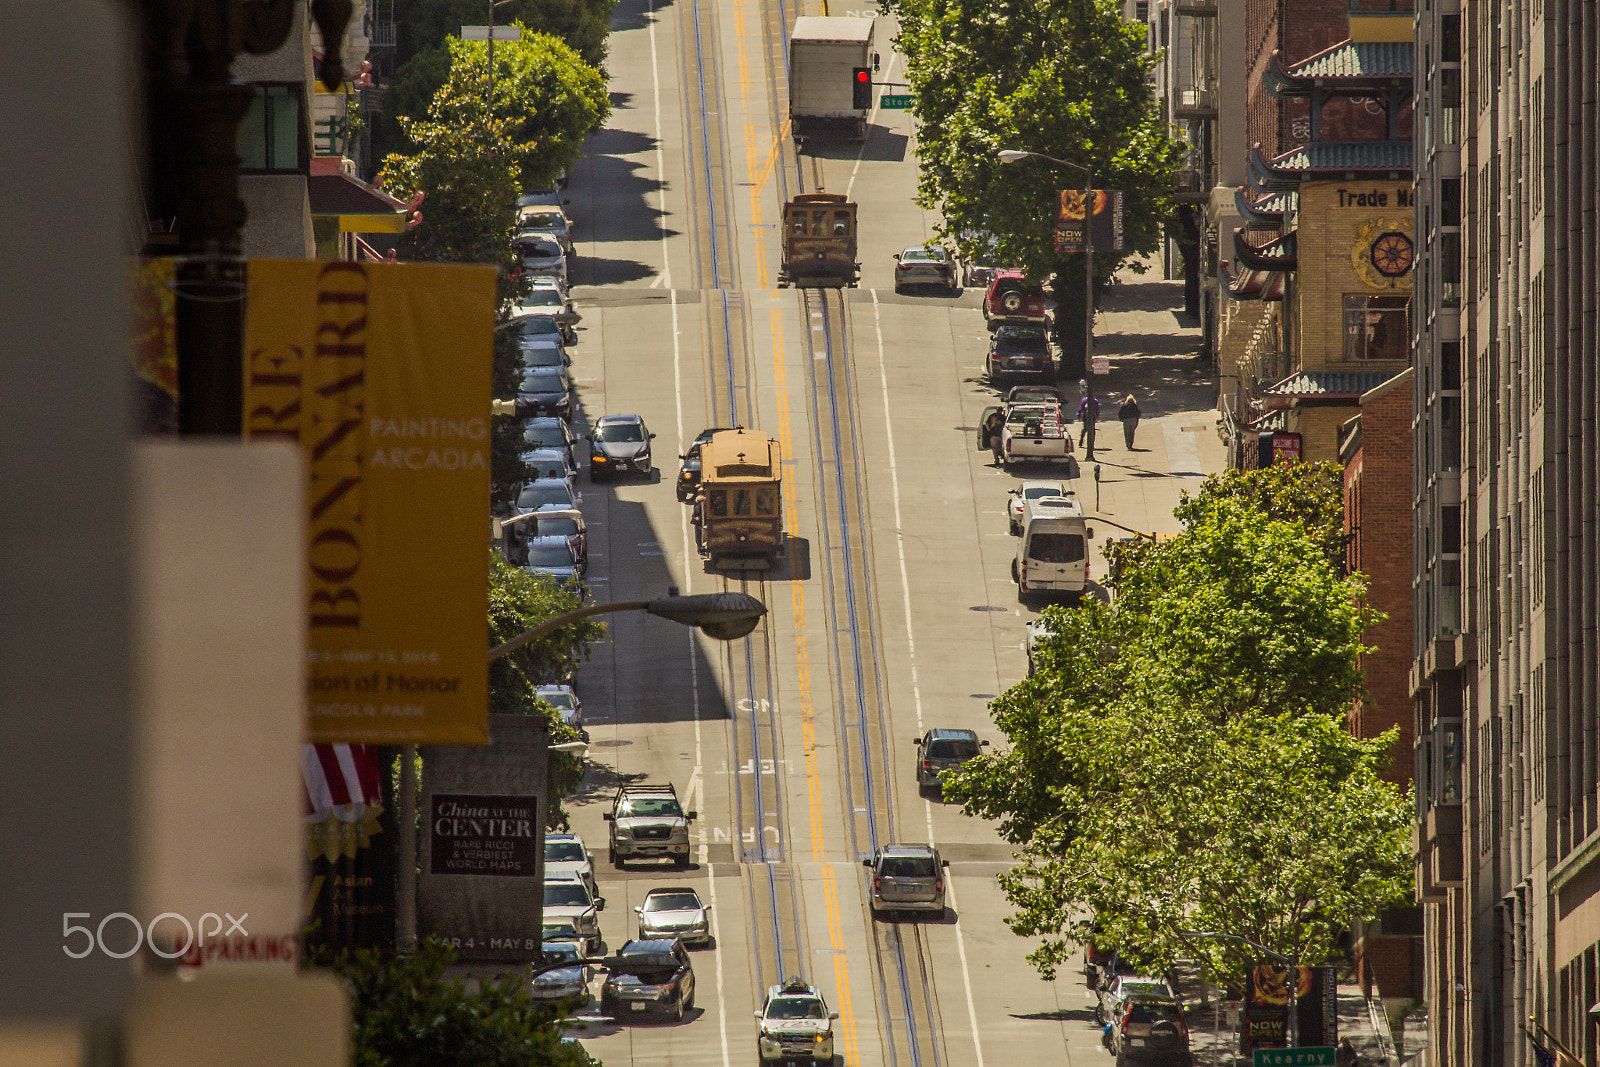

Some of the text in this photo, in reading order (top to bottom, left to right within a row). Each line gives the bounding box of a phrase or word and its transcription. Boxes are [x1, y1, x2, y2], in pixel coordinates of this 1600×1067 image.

[1337, 188, 1388, 207] Trade
[369, 417, 488, 441] PAINTING
[309, 261, 369, 628] BONNARD
[369, 448, 487, 470] ARCADIA
[354, 671, 380, 693] of
[386, 671, 461, 693] Honor
[380, 703, 425, 717] PARK
[714, 759, 795, 774] LEFT
[437, 802, 488, 817] China
[434, 817, 532, 838] CENTER
[453, 840, 514, 850] RARE RICCI
[452, 850, 514, 860] & VERBIEST
[445, 860, 521, 870] WORLD MAPS
[333, 875, 373, 887] Asian
[333, 902, 384, 916] Museum
[204, 934, 295, 962] PARKING
[465, 938, 475, 949] 4
[490, 938, 520, 949] MAY
[525, 938, 534, 950] 8
[1250, 1021, 1283, 1030] NOW
[1250, 1029, 1282, 1037] OPEN
[1262, 1053, 1325, 1065] Kearny
